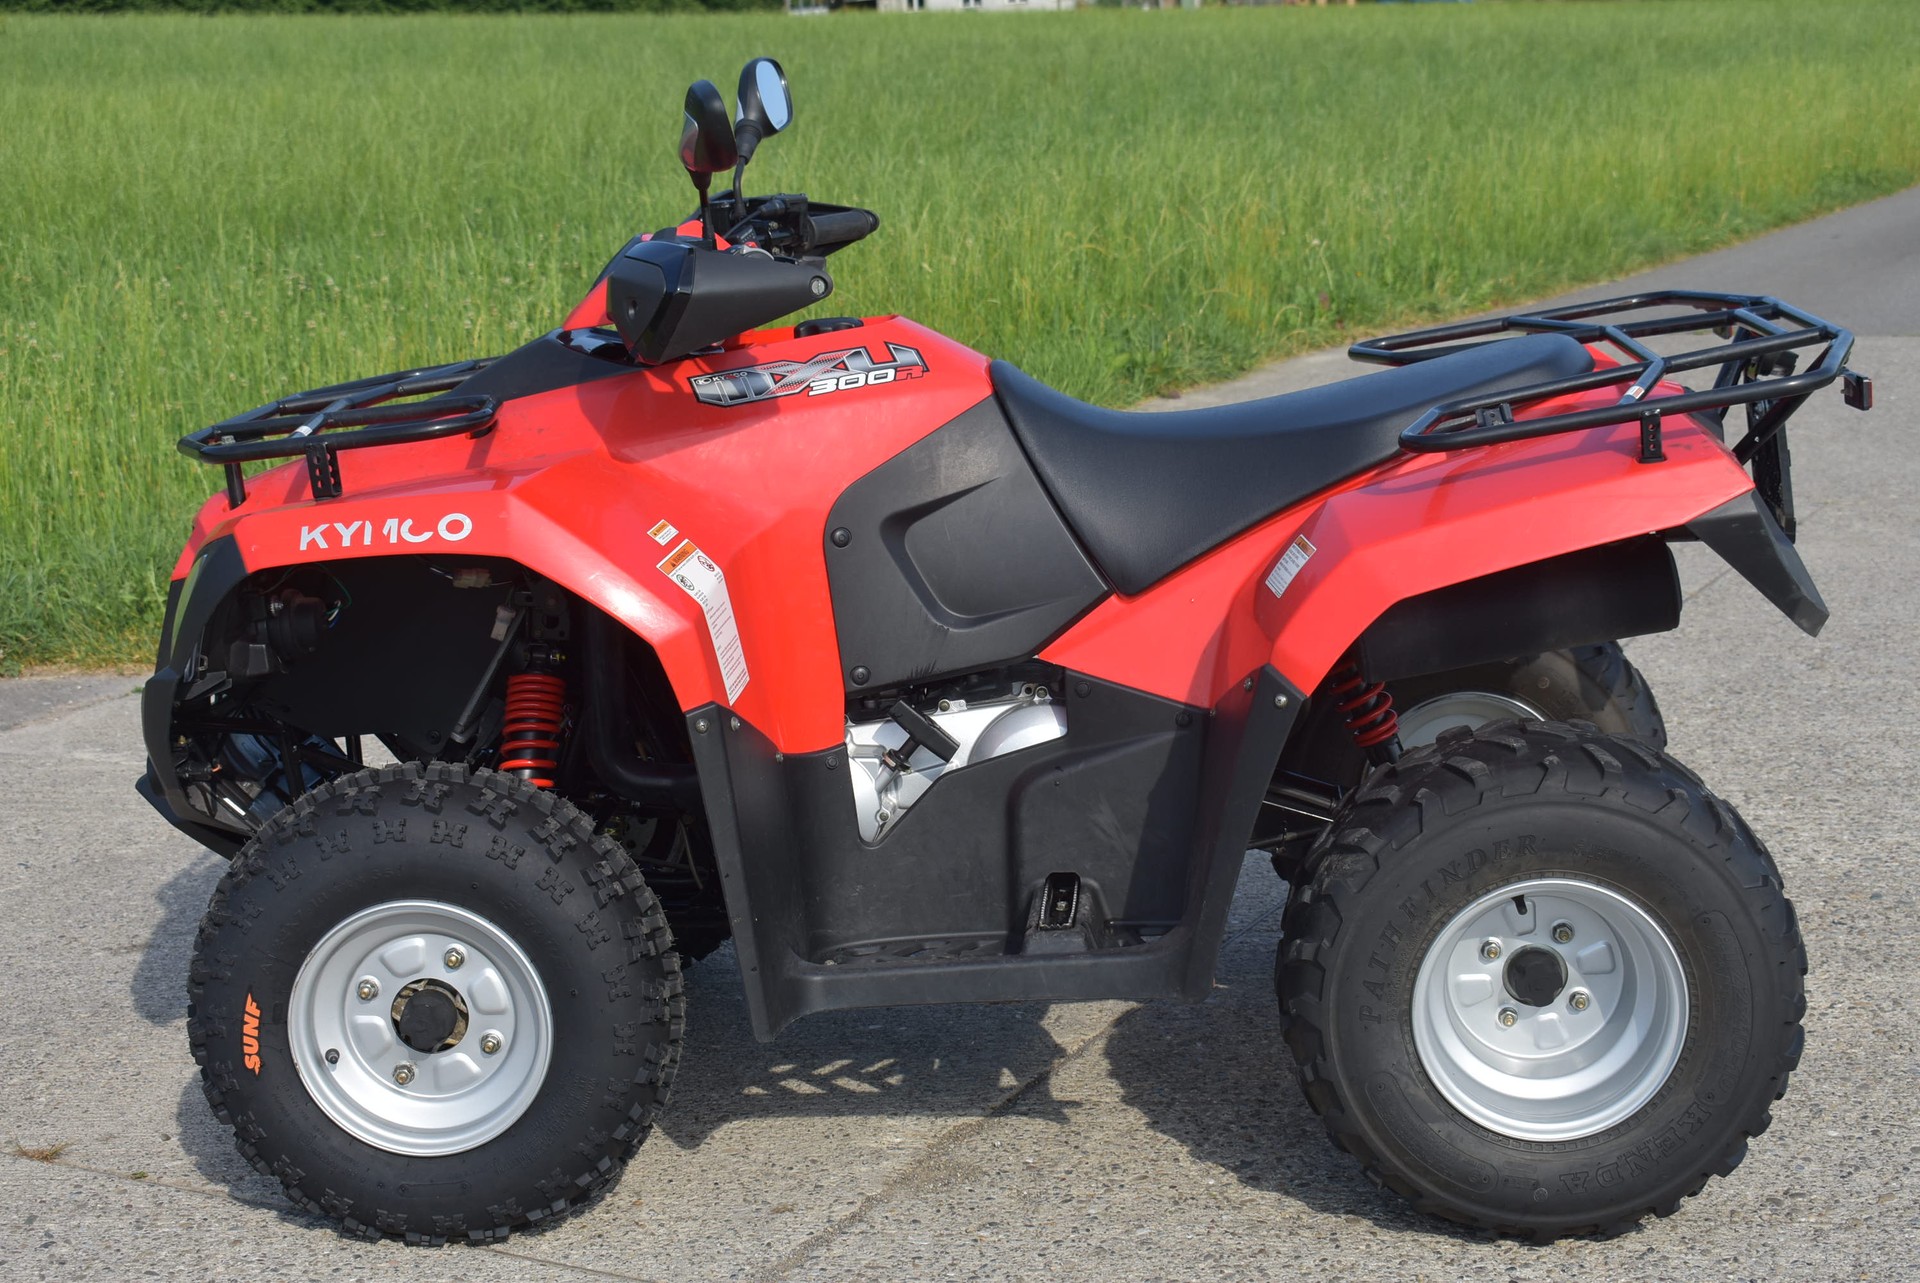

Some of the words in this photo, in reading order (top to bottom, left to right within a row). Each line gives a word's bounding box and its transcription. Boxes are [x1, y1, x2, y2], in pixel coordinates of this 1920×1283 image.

[1359, 834, 1539, 1024] PATHFINDER
[243, 993, 261, 1075] SUNF
[1559, 1104, 1712, 1194] KENDA
